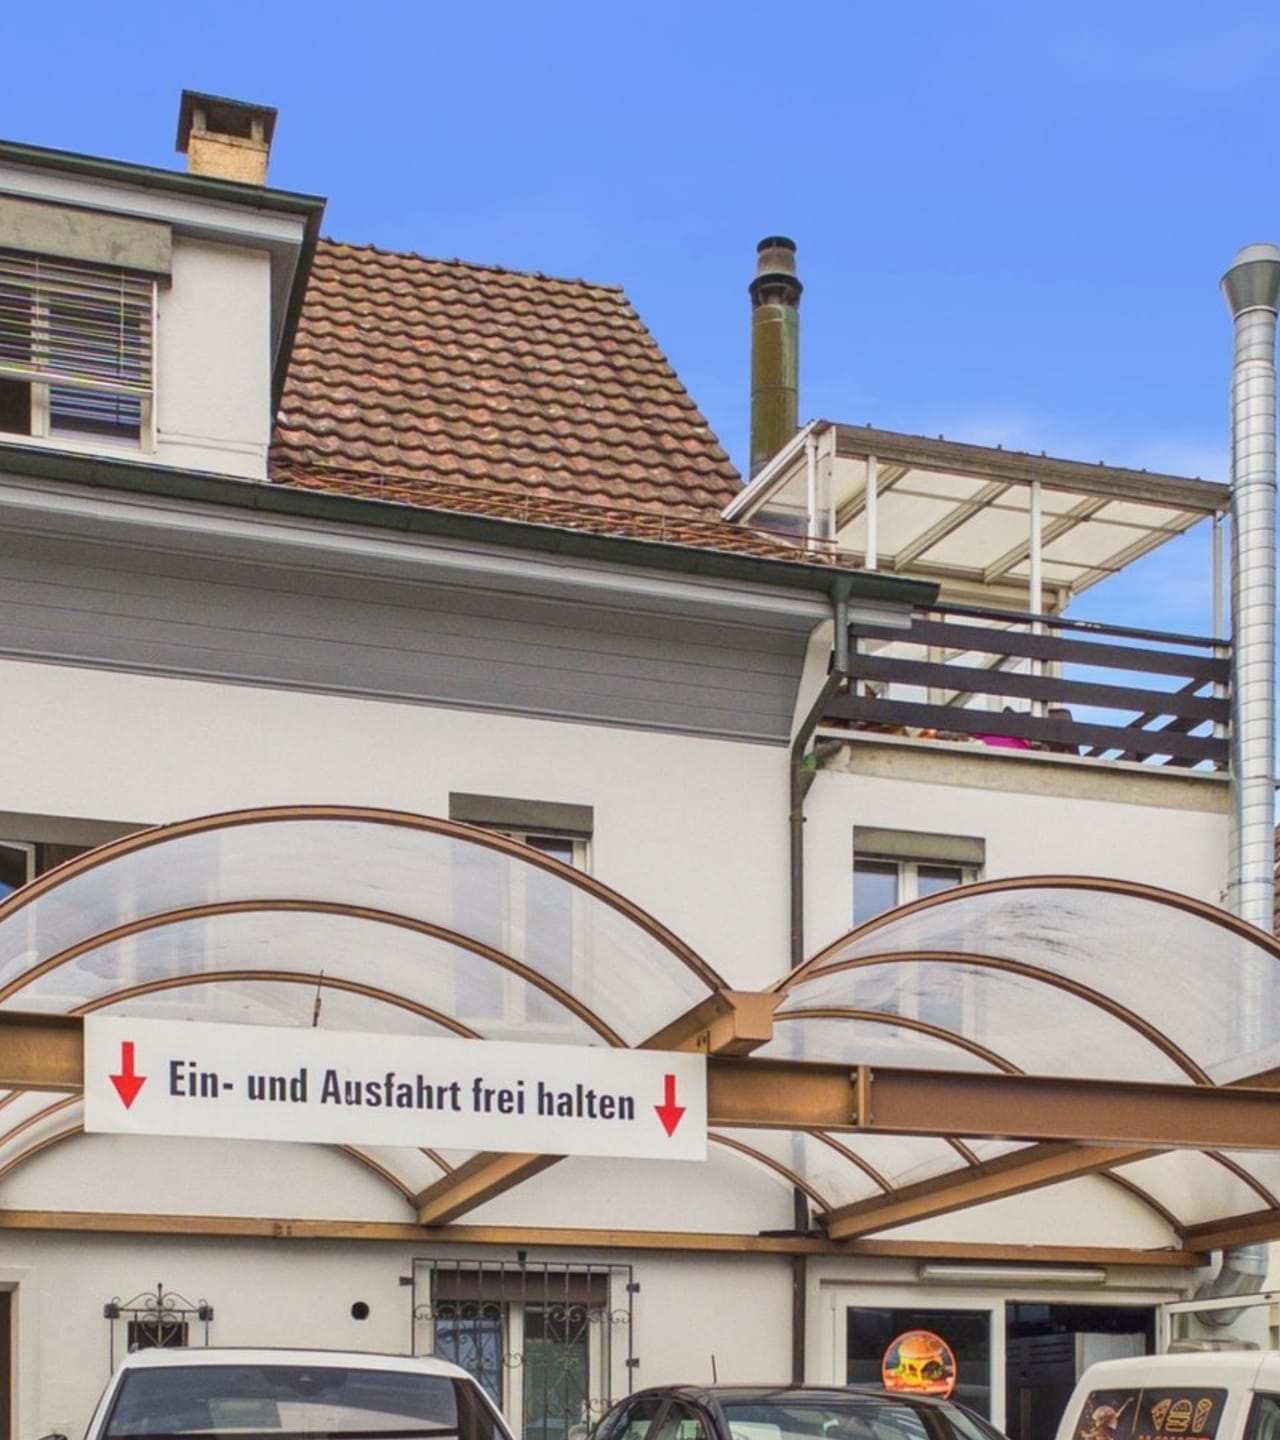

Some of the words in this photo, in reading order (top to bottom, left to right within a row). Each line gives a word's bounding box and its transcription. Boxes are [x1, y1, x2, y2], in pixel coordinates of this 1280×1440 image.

[170, 1060, 233, 1098] Ein-
[247, 1068, 308, 1103] und
[320, 1069, 462, 1112] Ausfahrt
[472, 1077, 524, 1115] frei
[537, 1081, 635, 1121] halten
